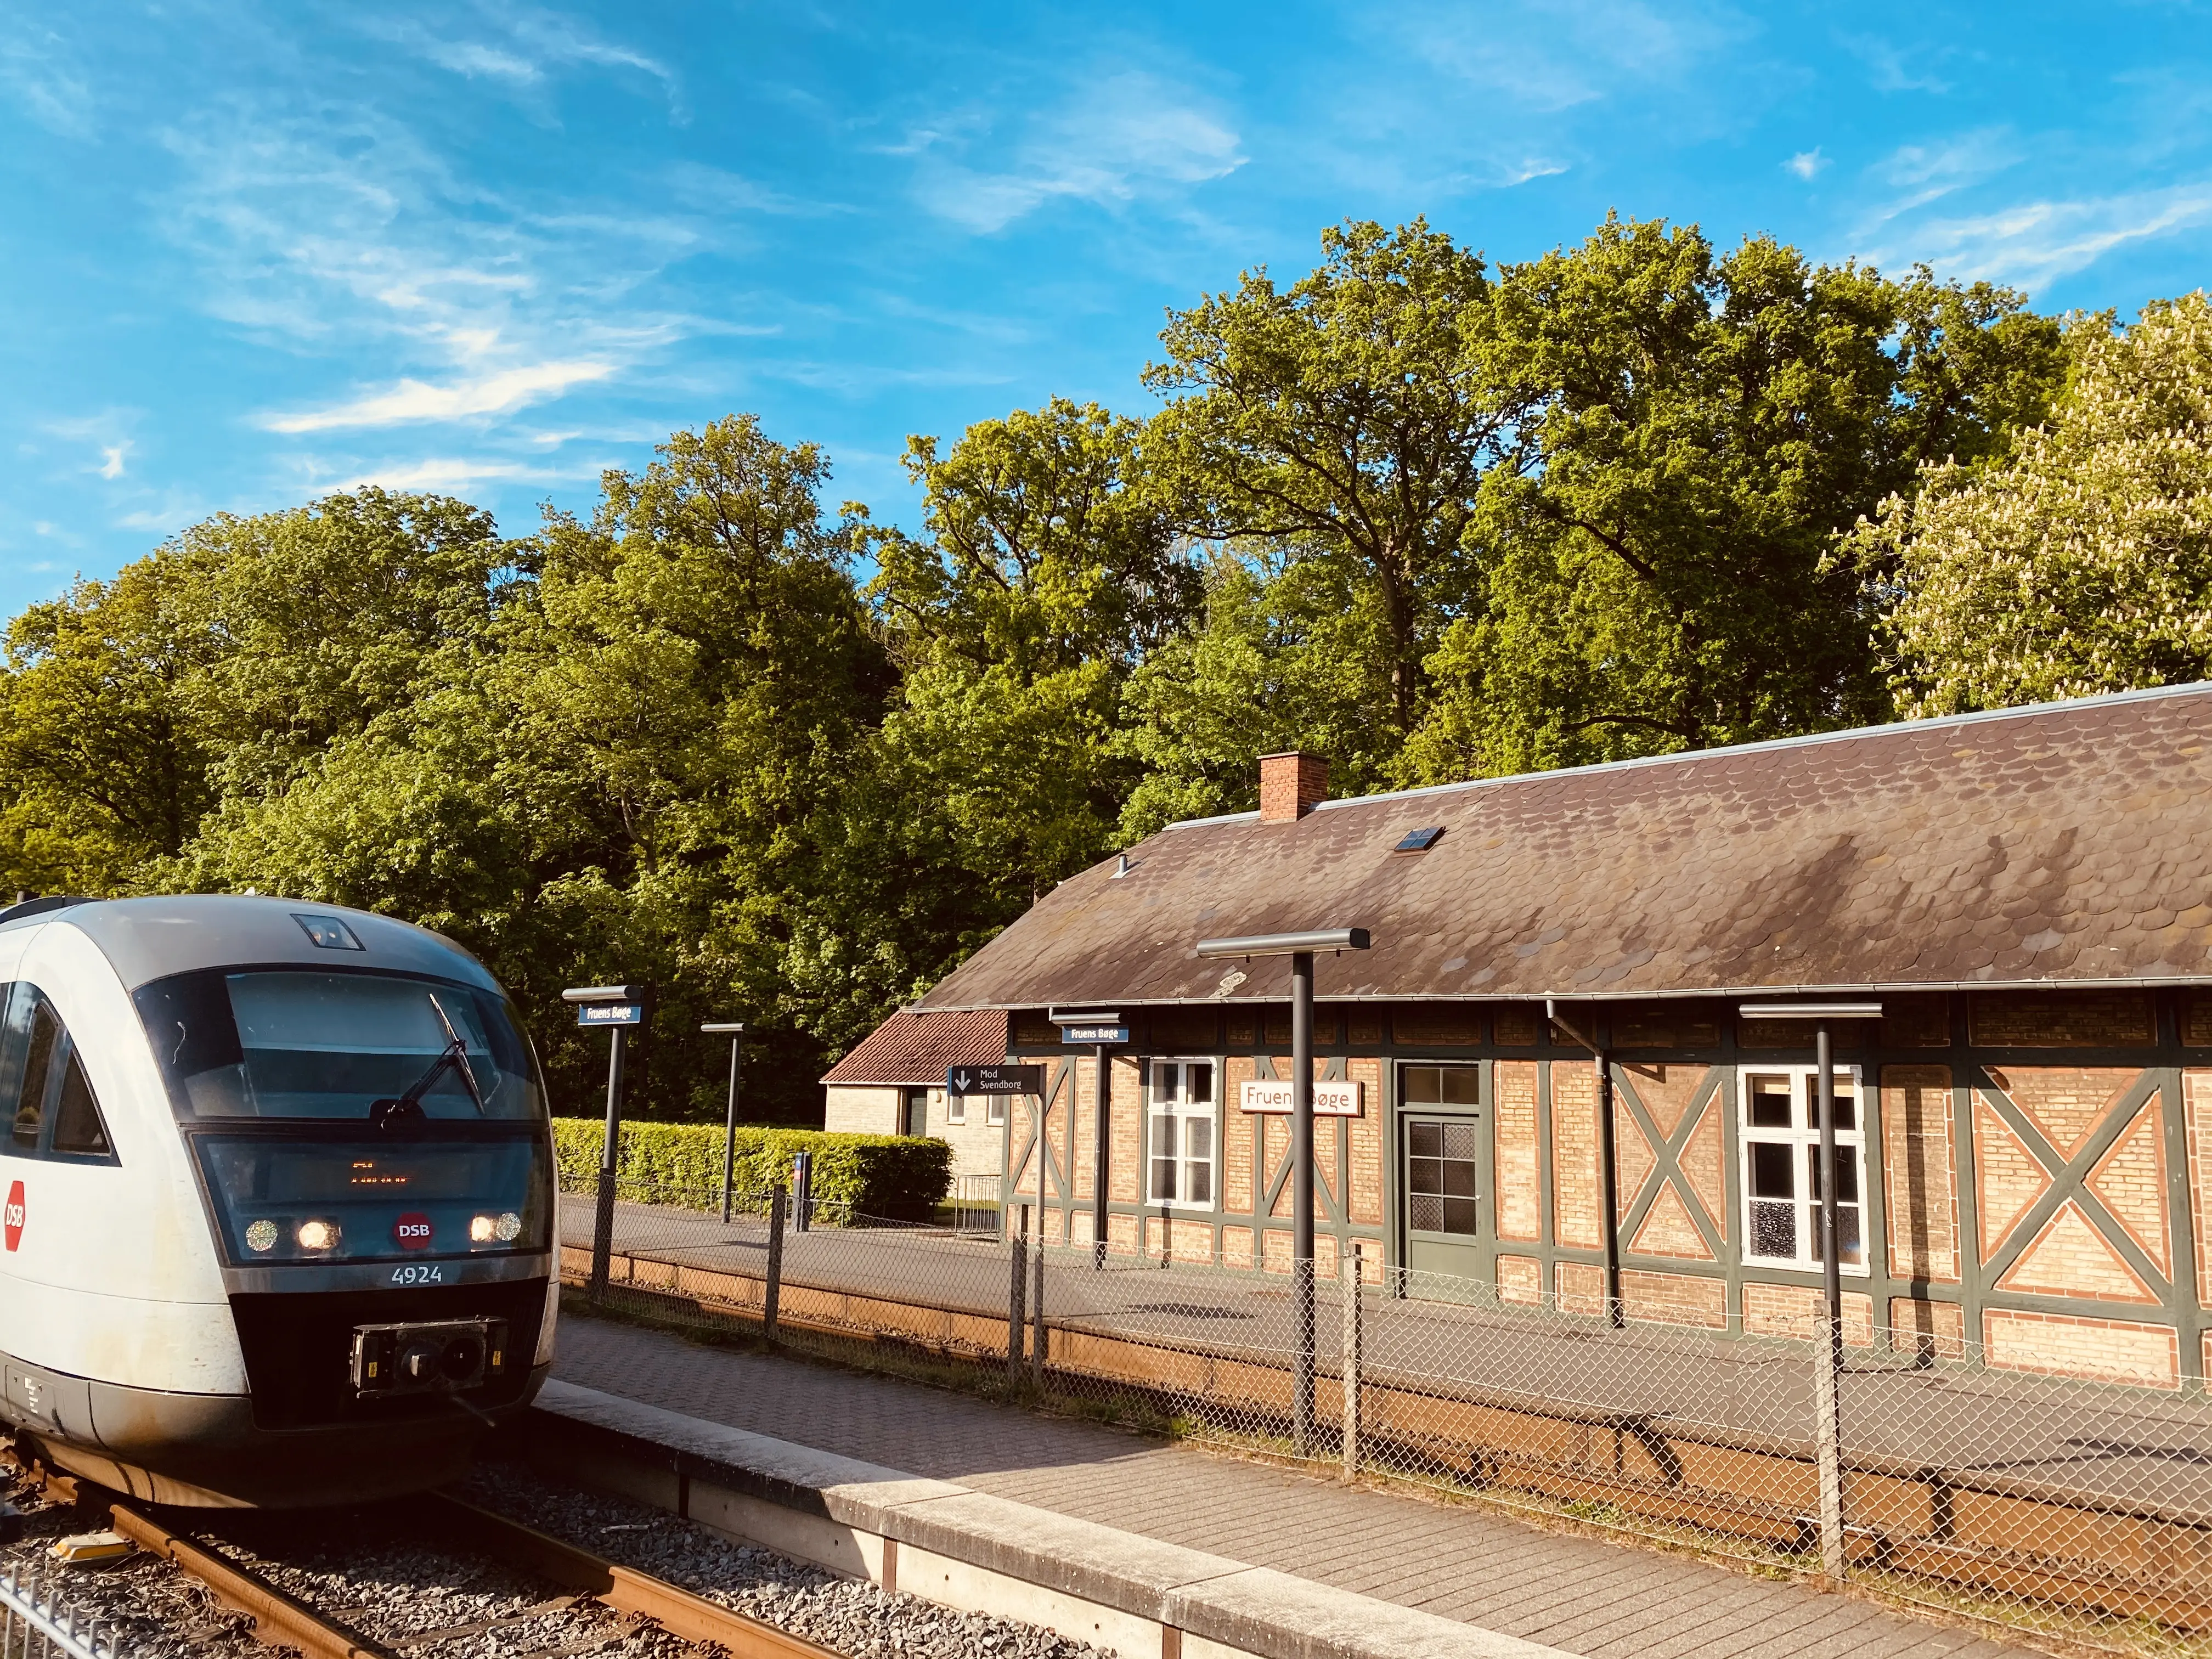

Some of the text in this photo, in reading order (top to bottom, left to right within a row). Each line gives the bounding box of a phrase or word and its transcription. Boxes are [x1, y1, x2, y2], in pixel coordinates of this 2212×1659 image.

[587, 1006, 631, 1020] Fruens Bøge
[1071, 1029, 1119, 1040] Fruens Bøge
[980, 1070, 998, 1079] Mod
[980, 1080, 1022, 1090] Svendborg
[1248, 1087, 1350, 1111] Fruen øge
[6, 1204, 23, 1228] DSB
[399, 1224, 430, 1237] DSB
[391, 1266, 442, 1284] 4924
